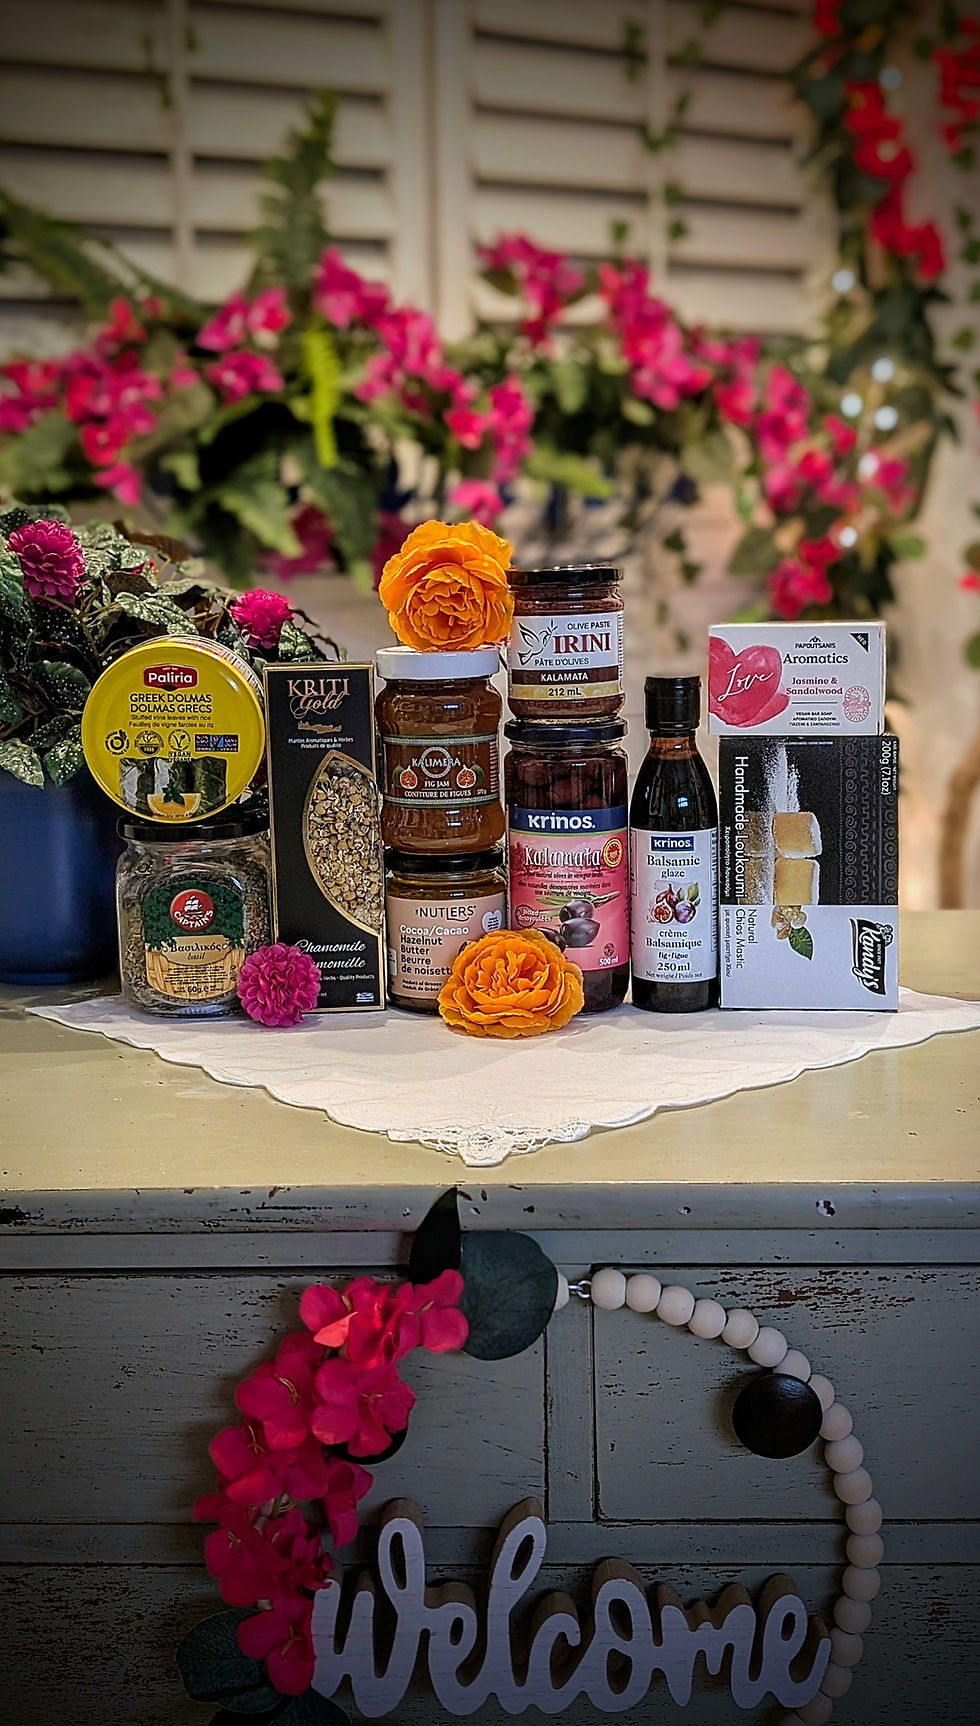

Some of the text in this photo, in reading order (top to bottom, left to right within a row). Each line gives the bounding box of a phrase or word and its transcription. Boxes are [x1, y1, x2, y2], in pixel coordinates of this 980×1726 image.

[567, 621, 611, 630] OLIVE PASTE
[553, 632, 611, 654] IRINI
[535, 657, 589, 666] PÂTE D'OLIVES
[783, 653, 849, 664] Aromatics
[148, 671, 193, 684] Paliria
[540, 672, 588, 682] KALAMATA
[717, 663, 774, 702] Love
[792, 677, 838, 685] Jasmine &
[286, 678, 351, 697] KRITI
[548, 687, 582, 696] 212 mL
[786, 686, 843, 695] Sandalwood
[129, 693, 212, 703] GREEK DOLMAS
[130, 704, 212, 713] DOLMAS GRECS
[290, 690, 345, 719] Gold
[412, 757, 461, 767] KALIMERA
[880, 740, 892, 796] 200g (7.1oz)
[424, 780, 450, 788] FIG JAM
[404, 790, 438, 798] CONFITURE
[440, 790, 449, 798] DE
[449, 789, 471, 797] FIGUES
[734, 756, 750, 898] Handmade Loukoumi
[525, 847, 601, 867] Kalamata
[647, 854, 700, 867] Balsamic
[661, 869, 685, 879] glaze
[174, 910, 214, 929] CAPTAIN'S
[400, 924, 469, 936] Cocoa/Cacao
[747, 909, 757, 944] Natural
[659, 929, 688, 938] crème
[735, 909, 746, 969] Chios Mastic
[400, 935, 443, 945] Hazelnut
[646, 937, 702, 950] Balsamique
[294, 939, 366, 953] Chamomile
[400, 944, 430, 956] Butter
[187, 952, 206, 961] basil
[401, 954, 432, 966] Beurre
[599, 956, 619, 966] 500 ml
[853, 926, 881, 989] Kandy's
[401, 964, 412, 974] de
[657, 962, 690, 971] 250 ml
[310, 1513, 833, 1718] Welcome
